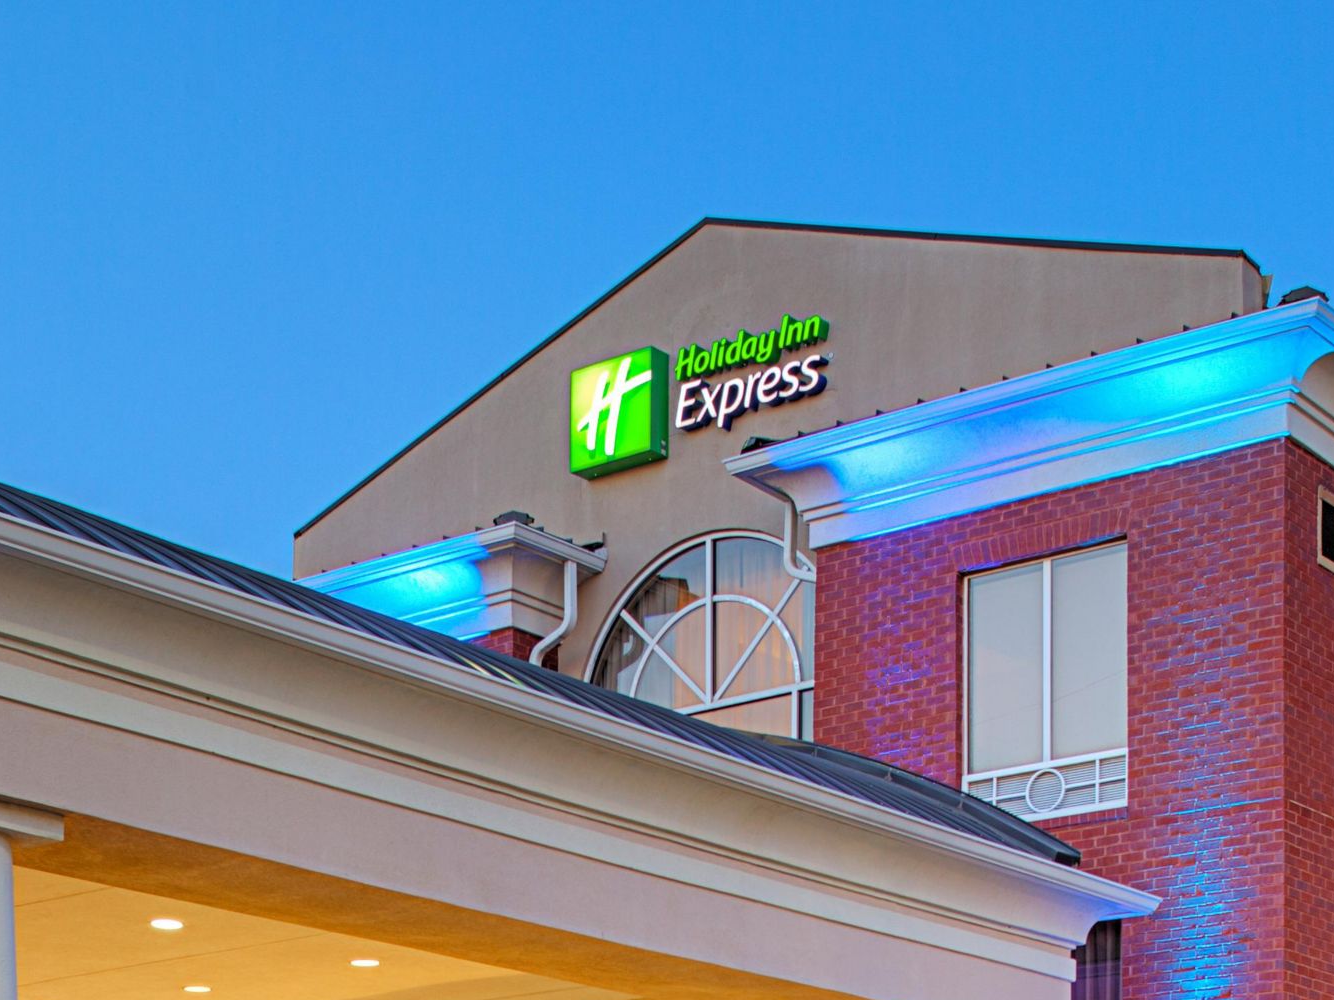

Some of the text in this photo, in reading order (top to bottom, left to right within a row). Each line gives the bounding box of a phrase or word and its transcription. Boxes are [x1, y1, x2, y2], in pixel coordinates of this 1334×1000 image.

[675, 314, 822, 381] Holiday Inn
[577, 357, 652, 456] H
[675, 354, 822, 429] Express
